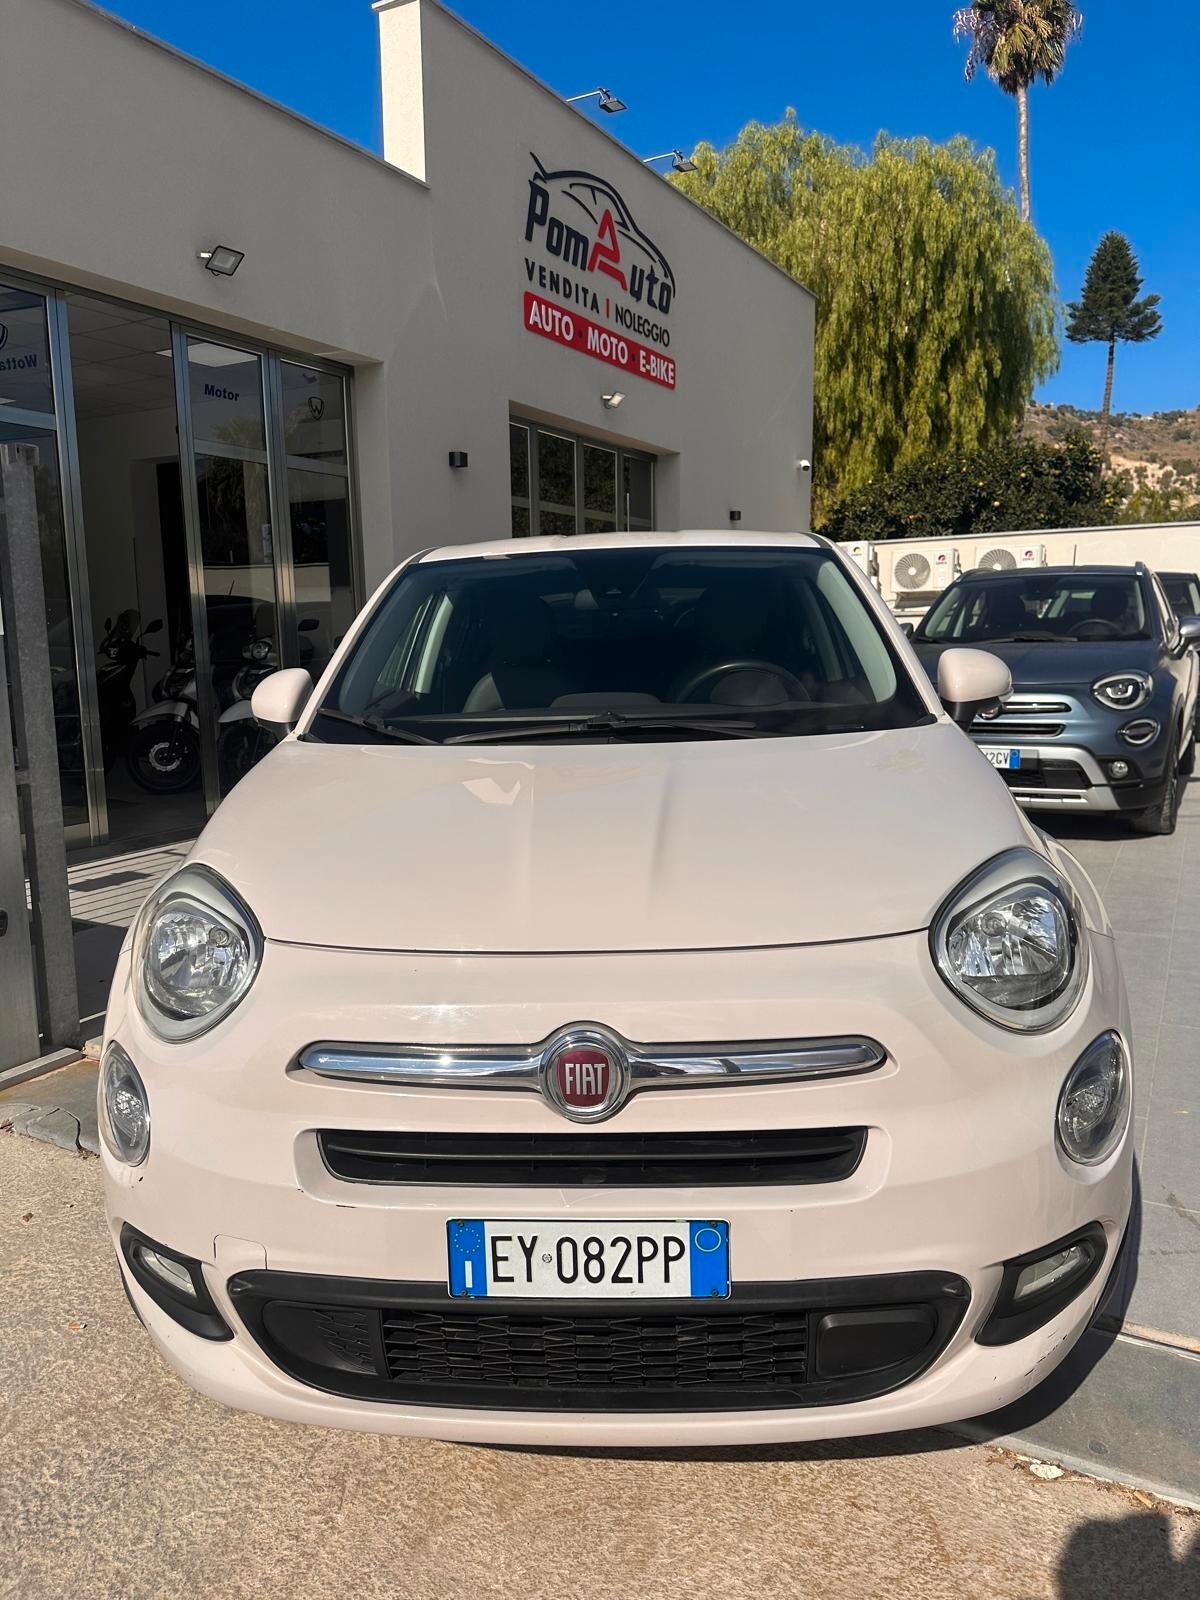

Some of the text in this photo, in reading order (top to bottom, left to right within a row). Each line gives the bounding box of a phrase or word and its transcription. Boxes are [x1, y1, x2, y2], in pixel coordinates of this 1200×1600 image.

[525, 179, 672, 314] PomAuto
[525, 257, 670, 347] VENDITA NOLEGGIO
[529, 300, 674, 385] AUTO MOTO E-BIKE
[204, 384, 240, 401] Motor
[565, 1063, 606, 1096] FIAT
[464, 1260, 473, 1288] I
[490, 1235, 686, 1284] EY 082PP
